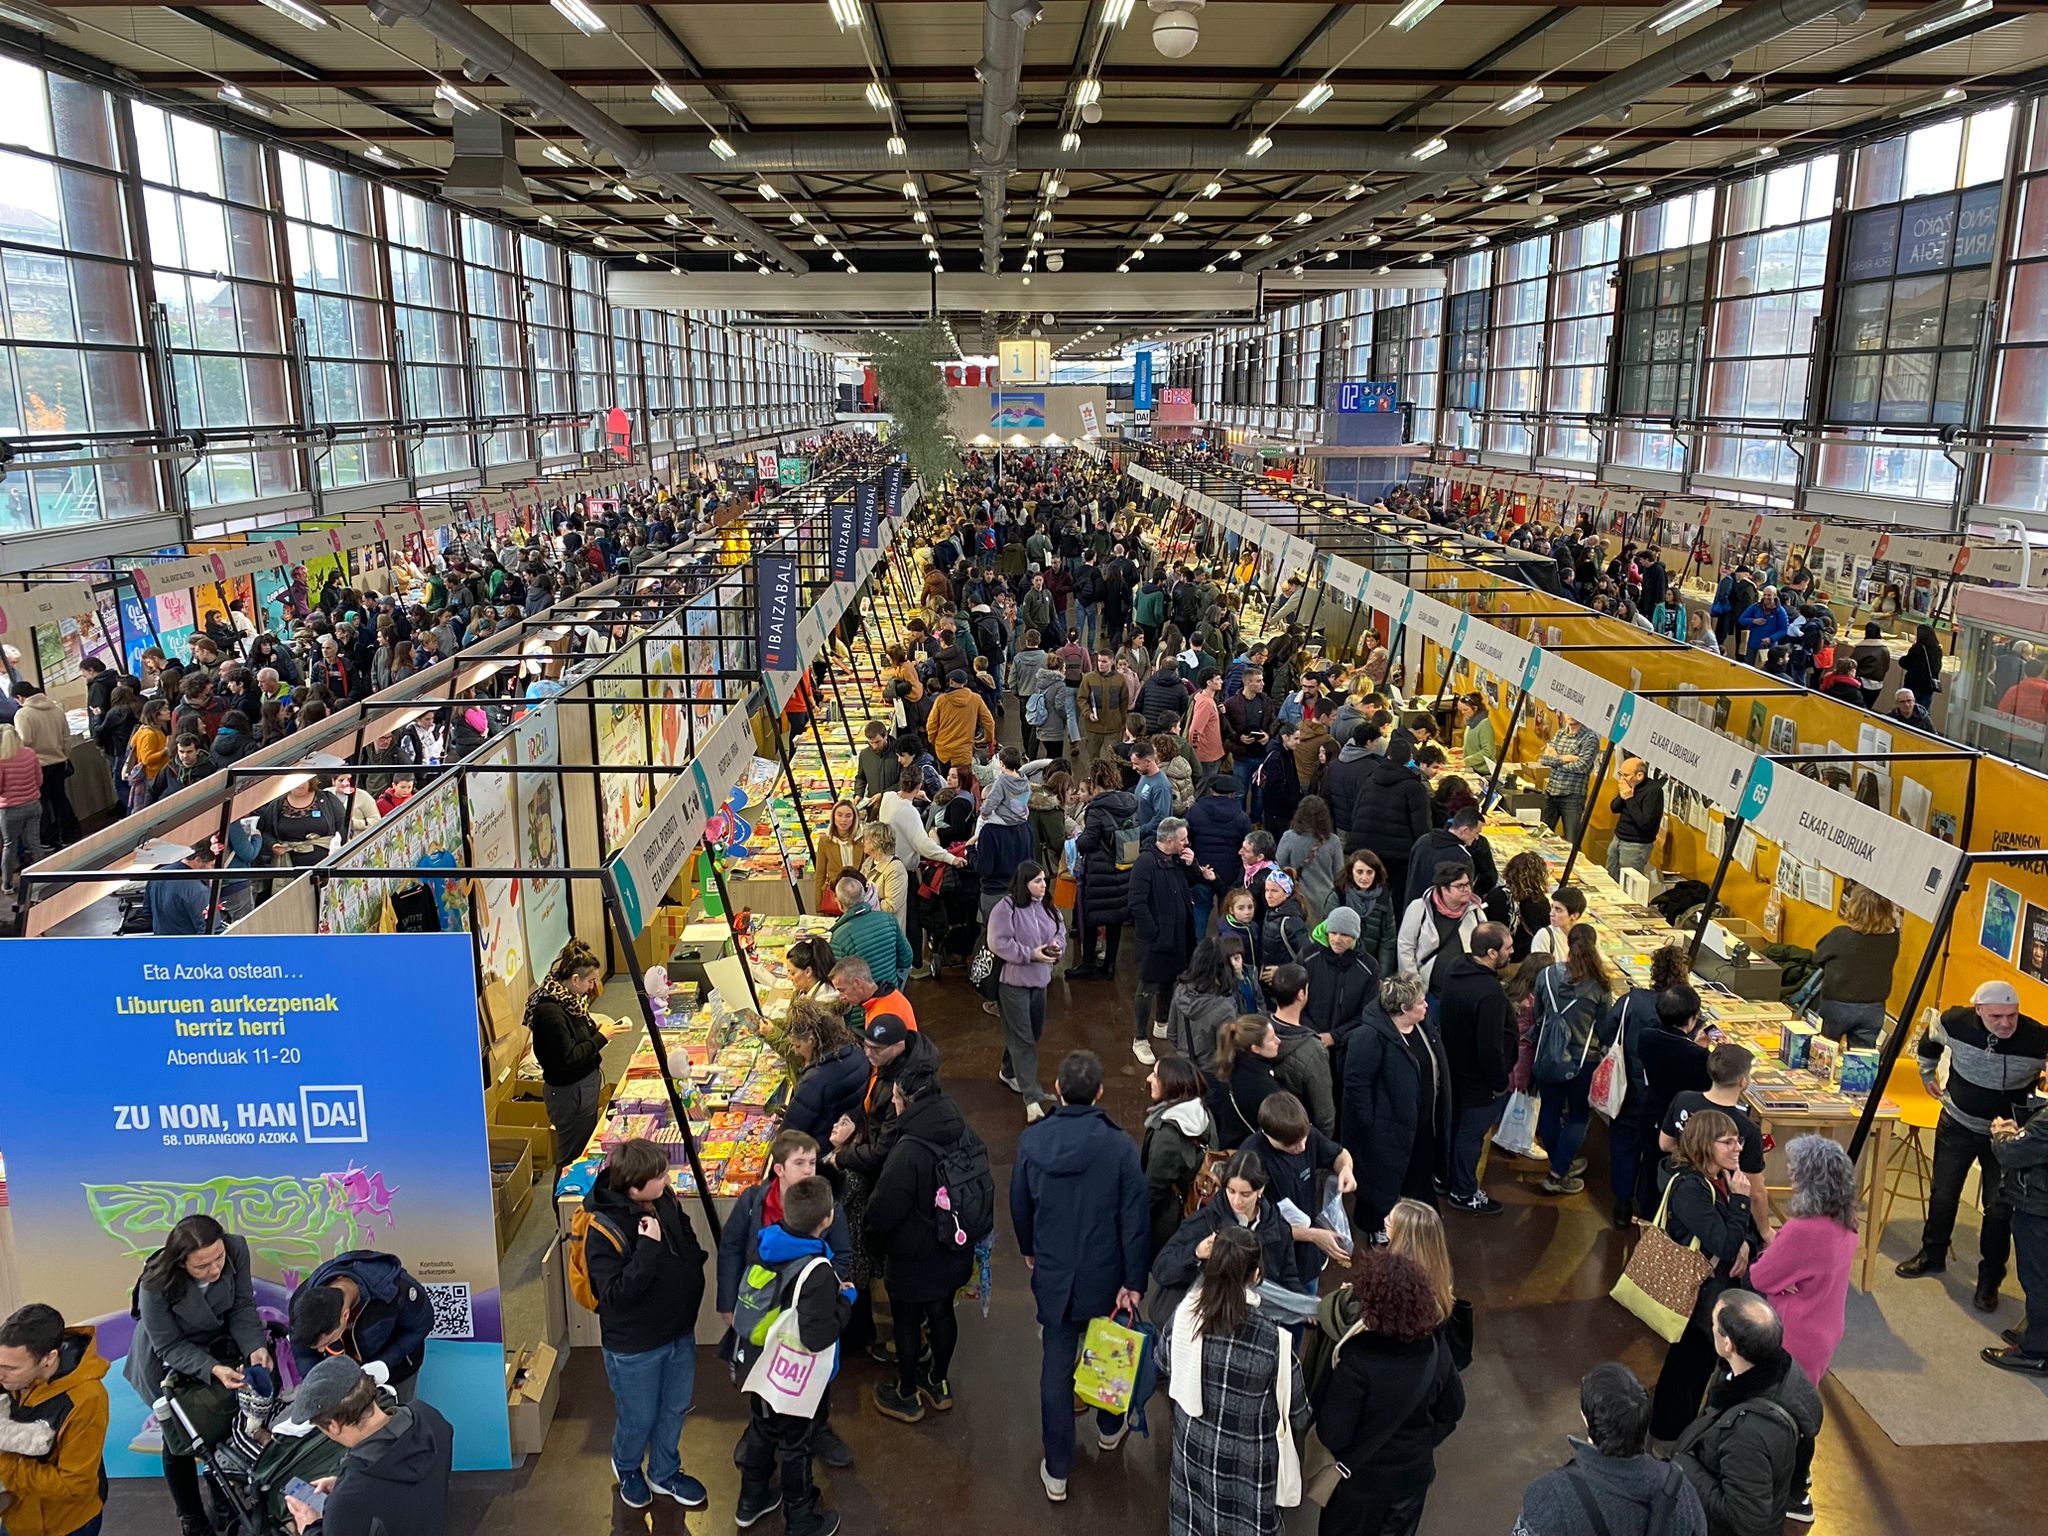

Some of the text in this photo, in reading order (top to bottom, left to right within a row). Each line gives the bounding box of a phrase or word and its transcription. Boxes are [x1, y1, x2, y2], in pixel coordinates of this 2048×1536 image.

[1342, 385, 1358, 410] 02
[1136, 413, 1149, 421] DA!
[760, 456, 775, 466] YA
[760, 467, 777, 477] NIZ
[889, 467, 900, 507] IBAIZABAL
[862, 486, 876, 537] IBAIZABAL
[836, 507, 854, 568] IBAIZABAL
[768, 562, 792, 650] IBAIZABAL
[1474, 640, 1503, 661] ELKAR LIBURUAK
[1529, 665, 1537, 679] 63
[1550, 679, 1586, 706] ELKAR LIBURUAK
[1619, 712, 1630, 727] 64
[1650, 731, 1700, 769] ELKAR LIBURUAK
[1752, 783, 1768, 804] 65
[659, 815, 678, 846] PORROTX
[1799, 811, 1876, 862] ELKAR LIBURUAK
[1993, 830, 2041, 849] DURANGON
[653, 835, 686, 893] ETA MARIMOTOTS
[624, 887, 634, 909] 1
[143, 964, 170, 981] Eta
[174, 963, 224, 980] Azoka
[116, 994, 339, 1015] Liburuen aurkezpenak
[175, 1018, 286, 1037] herriz herri
[166, 1047, 301, 1066] Abenduak 11-20
[113, 1101, 357, 1131] ZU NON, HAN DA!
[163, 1132, 298, 1146] 58. DURANGOKO AZOKA
[418, 1268, 456, 1276] aurkezpenak
[775, 1357, 808, 1382] DA!
